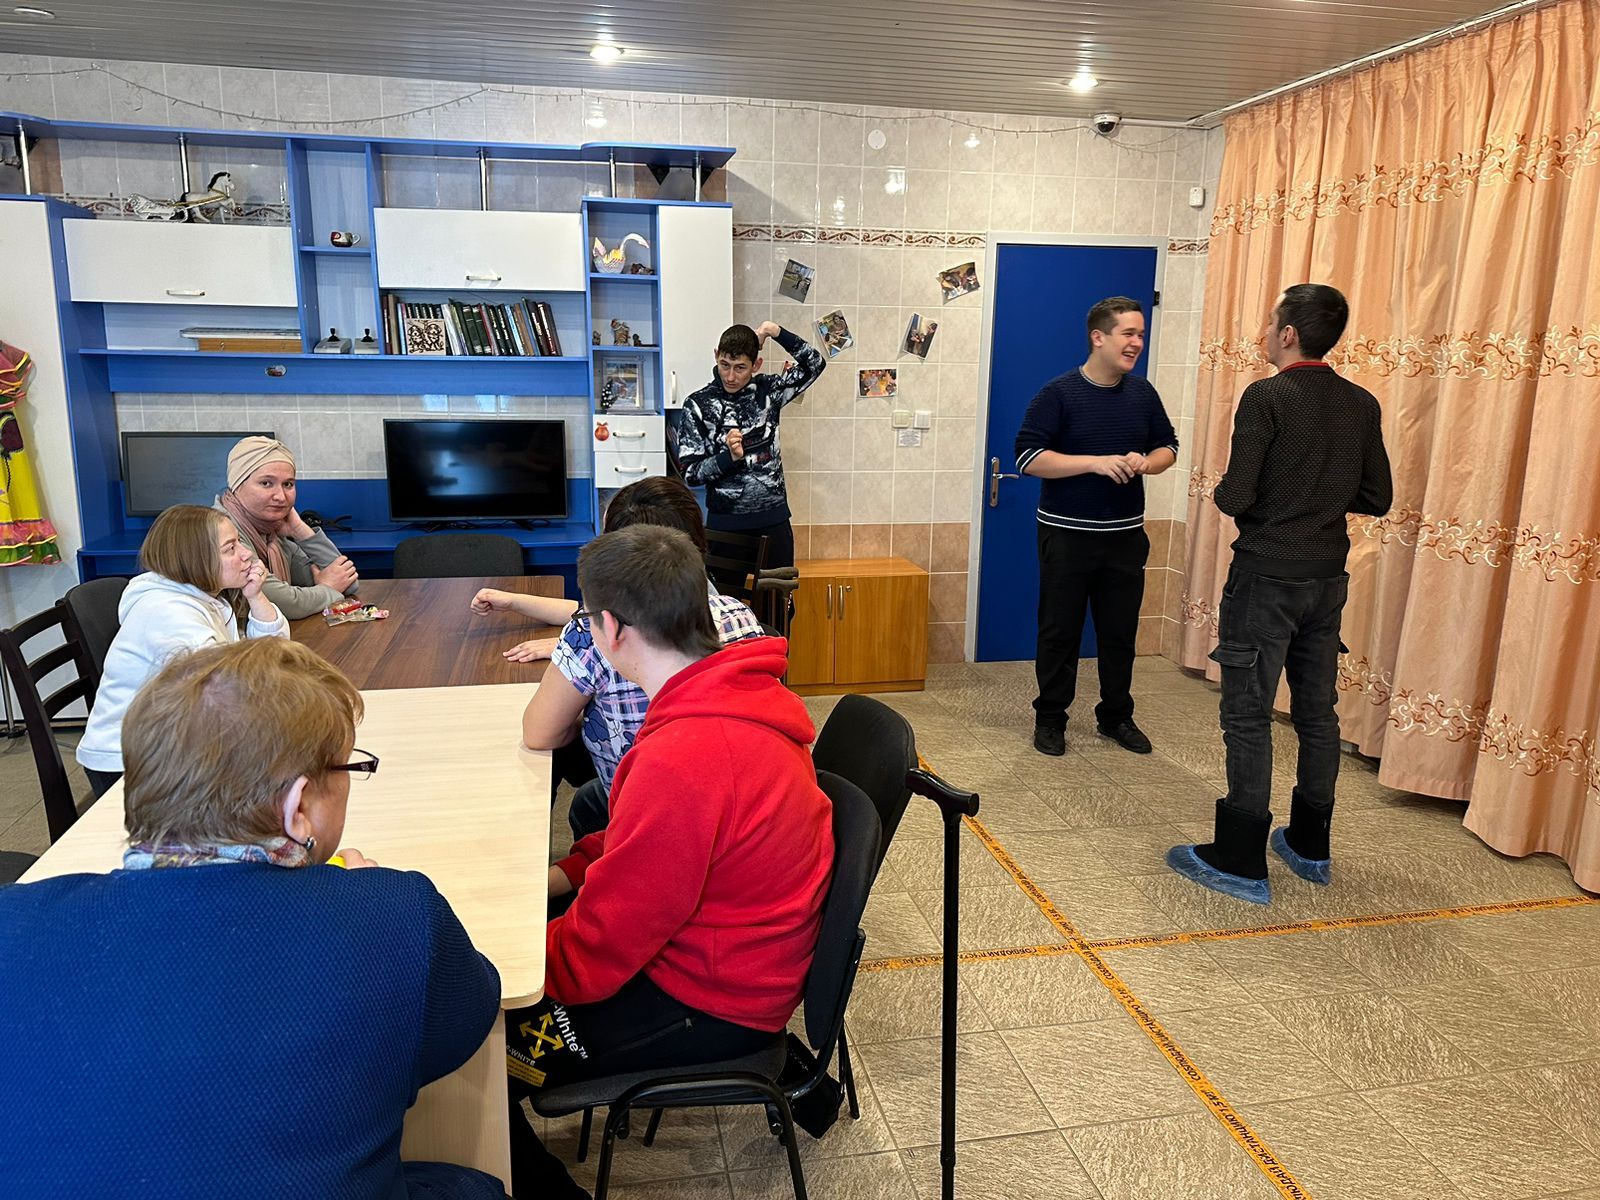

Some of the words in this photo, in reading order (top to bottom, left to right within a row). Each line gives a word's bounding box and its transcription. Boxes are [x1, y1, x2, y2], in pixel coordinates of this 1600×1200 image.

[1161, 1039, 1202, 1084] СОБЛЮДАЙ
[1212, 1098, 1229, 1115] 1,5
[1223, 1111, 1278, 1170] ДИСТАНЦИЮ
[1269, 1163, 1307, 1200] ЛЮДАЙ
